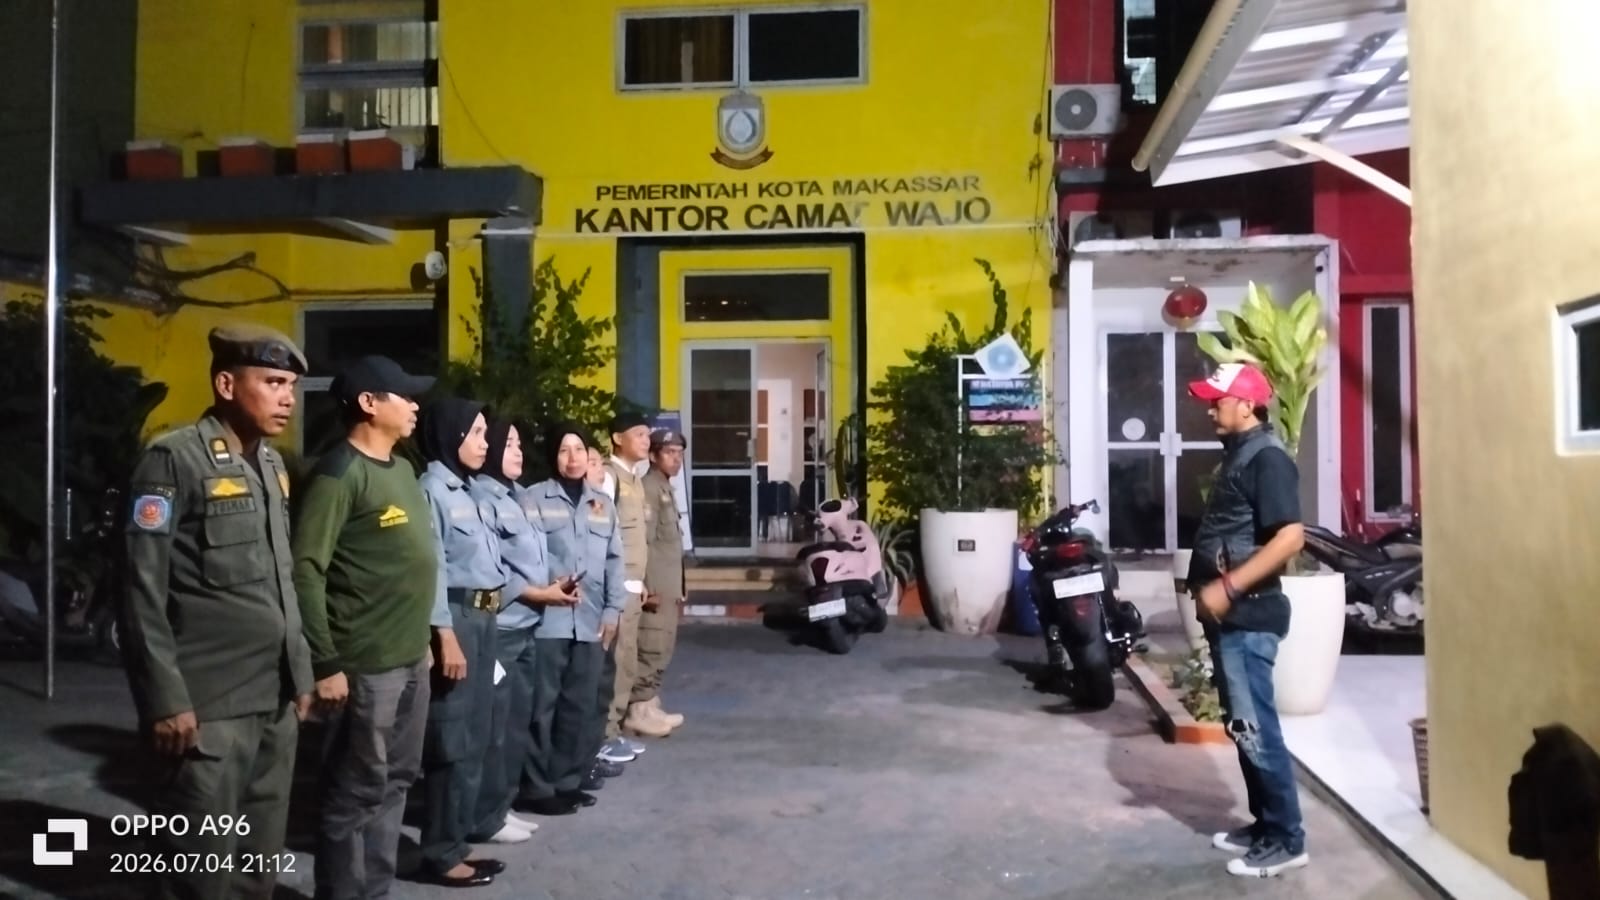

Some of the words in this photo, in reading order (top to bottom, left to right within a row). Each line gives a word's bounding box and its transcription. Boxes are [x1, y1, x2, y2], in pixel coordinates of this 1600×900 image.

[596, 183, 748, 201] PEMERINTAH
[758, 180, 824, 199] KOTA
[832, 175, 981, 196] MAKASSAR
[575, 205, 729, 233] KANTOR
[884, 197, 991, 227] WAJO
